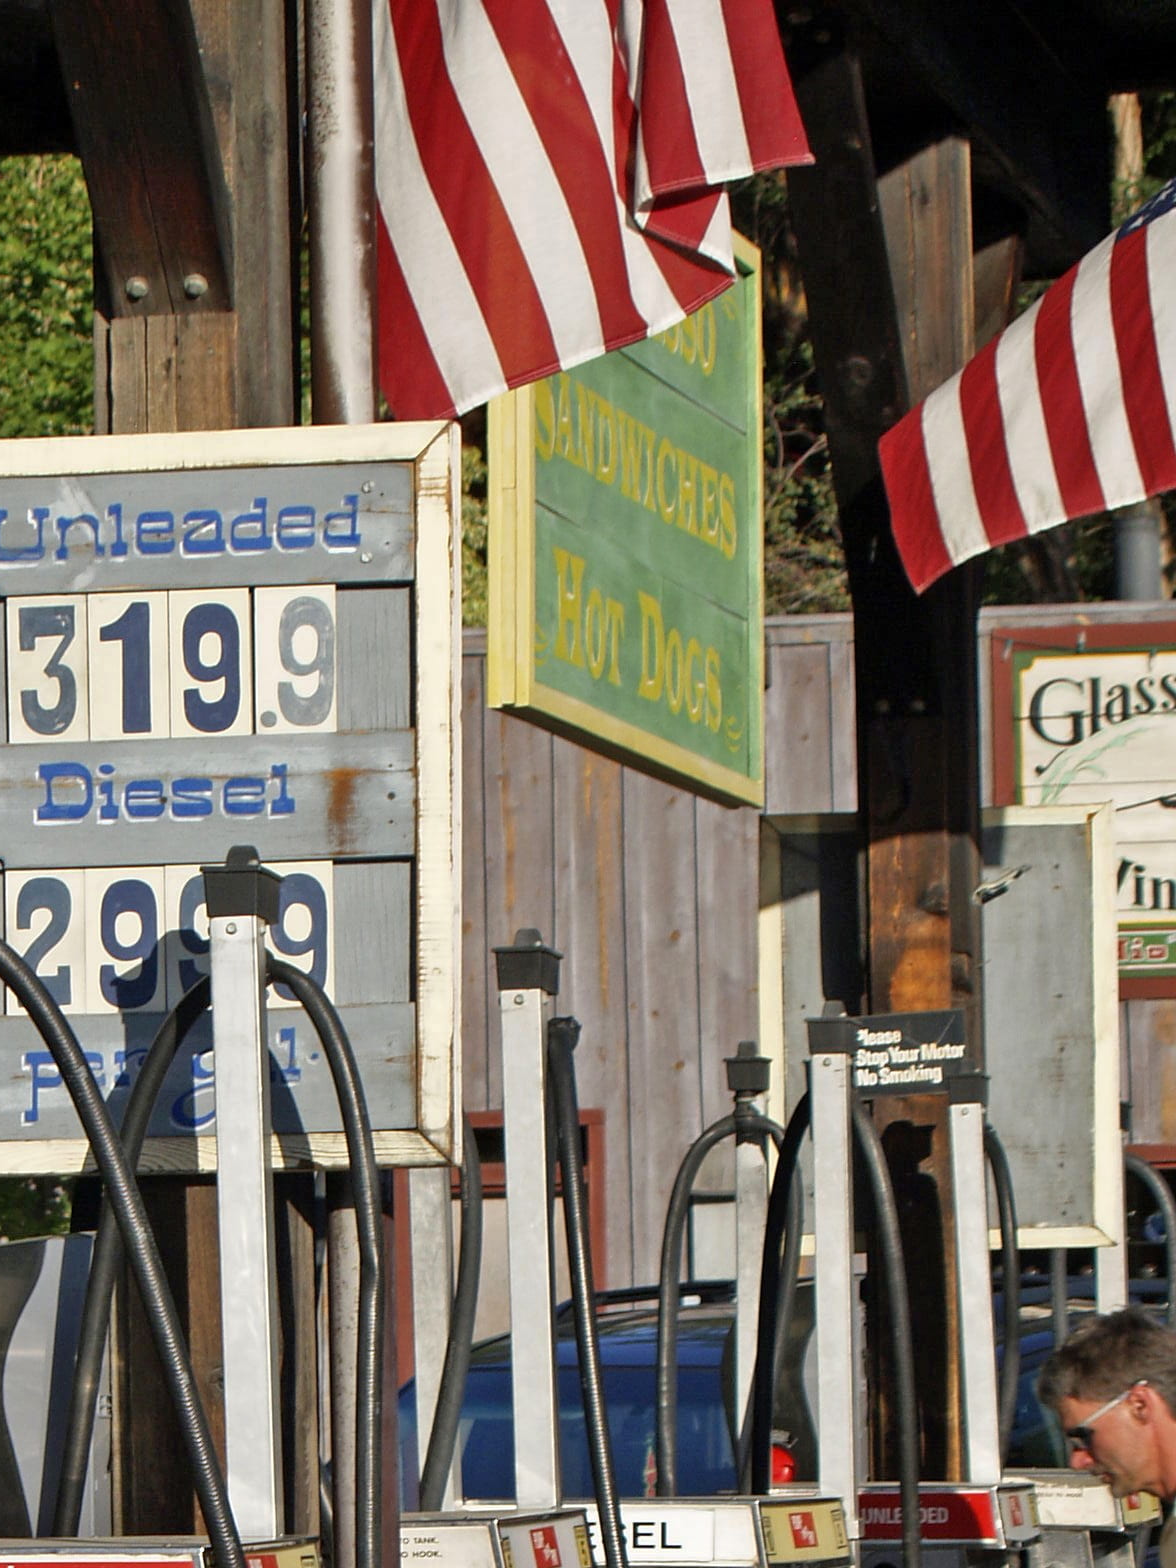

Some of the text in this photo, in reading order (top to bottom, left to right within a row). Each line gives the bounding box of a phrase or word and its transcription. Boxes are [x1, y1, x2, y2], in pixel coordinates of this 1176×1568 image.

[535, 373, 737, 560] SANDWICHES
[553, 546, 723, 733] HOT DOGS
[33, 761, 297, 826] Diesel
[171, 1026, 320, 1130] gl.
[857, 1042, 966, 1068] Stop Your Motor
[857, 1064, 943, 1086] No Smoking
[861, 1507, 949, 1524] UNLEDED
